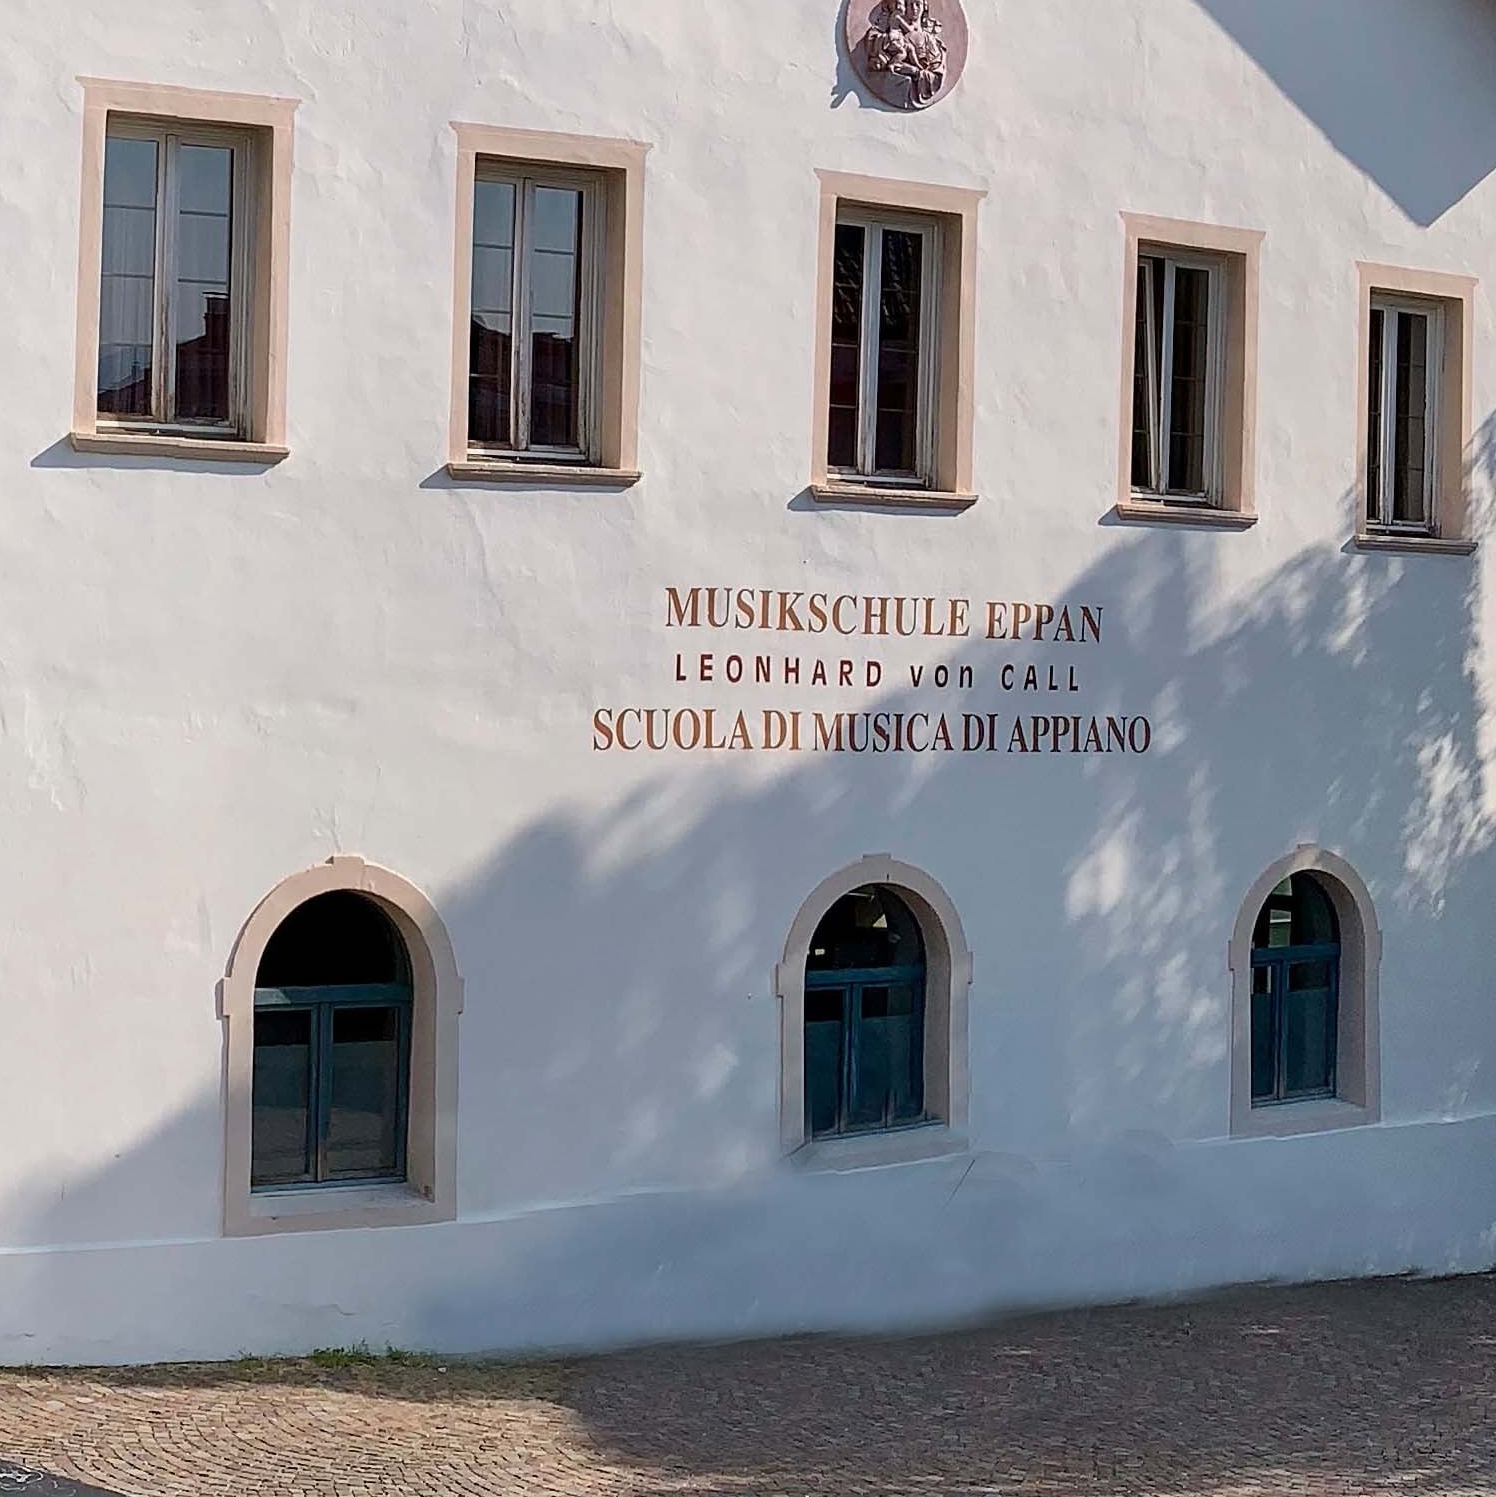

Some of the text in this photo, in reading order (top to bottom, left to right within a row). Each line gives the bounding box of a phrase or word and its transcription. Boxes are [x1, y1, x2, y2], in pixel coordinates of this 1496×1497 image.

[665, 587, 1105, 644] MUSIKSCHULE EPPAN
[676, 653, 1079, 691] LEONHARD von CALL
[592, 708, 1151, 754] SCUOLA DI MUSICA DI APPIANO
